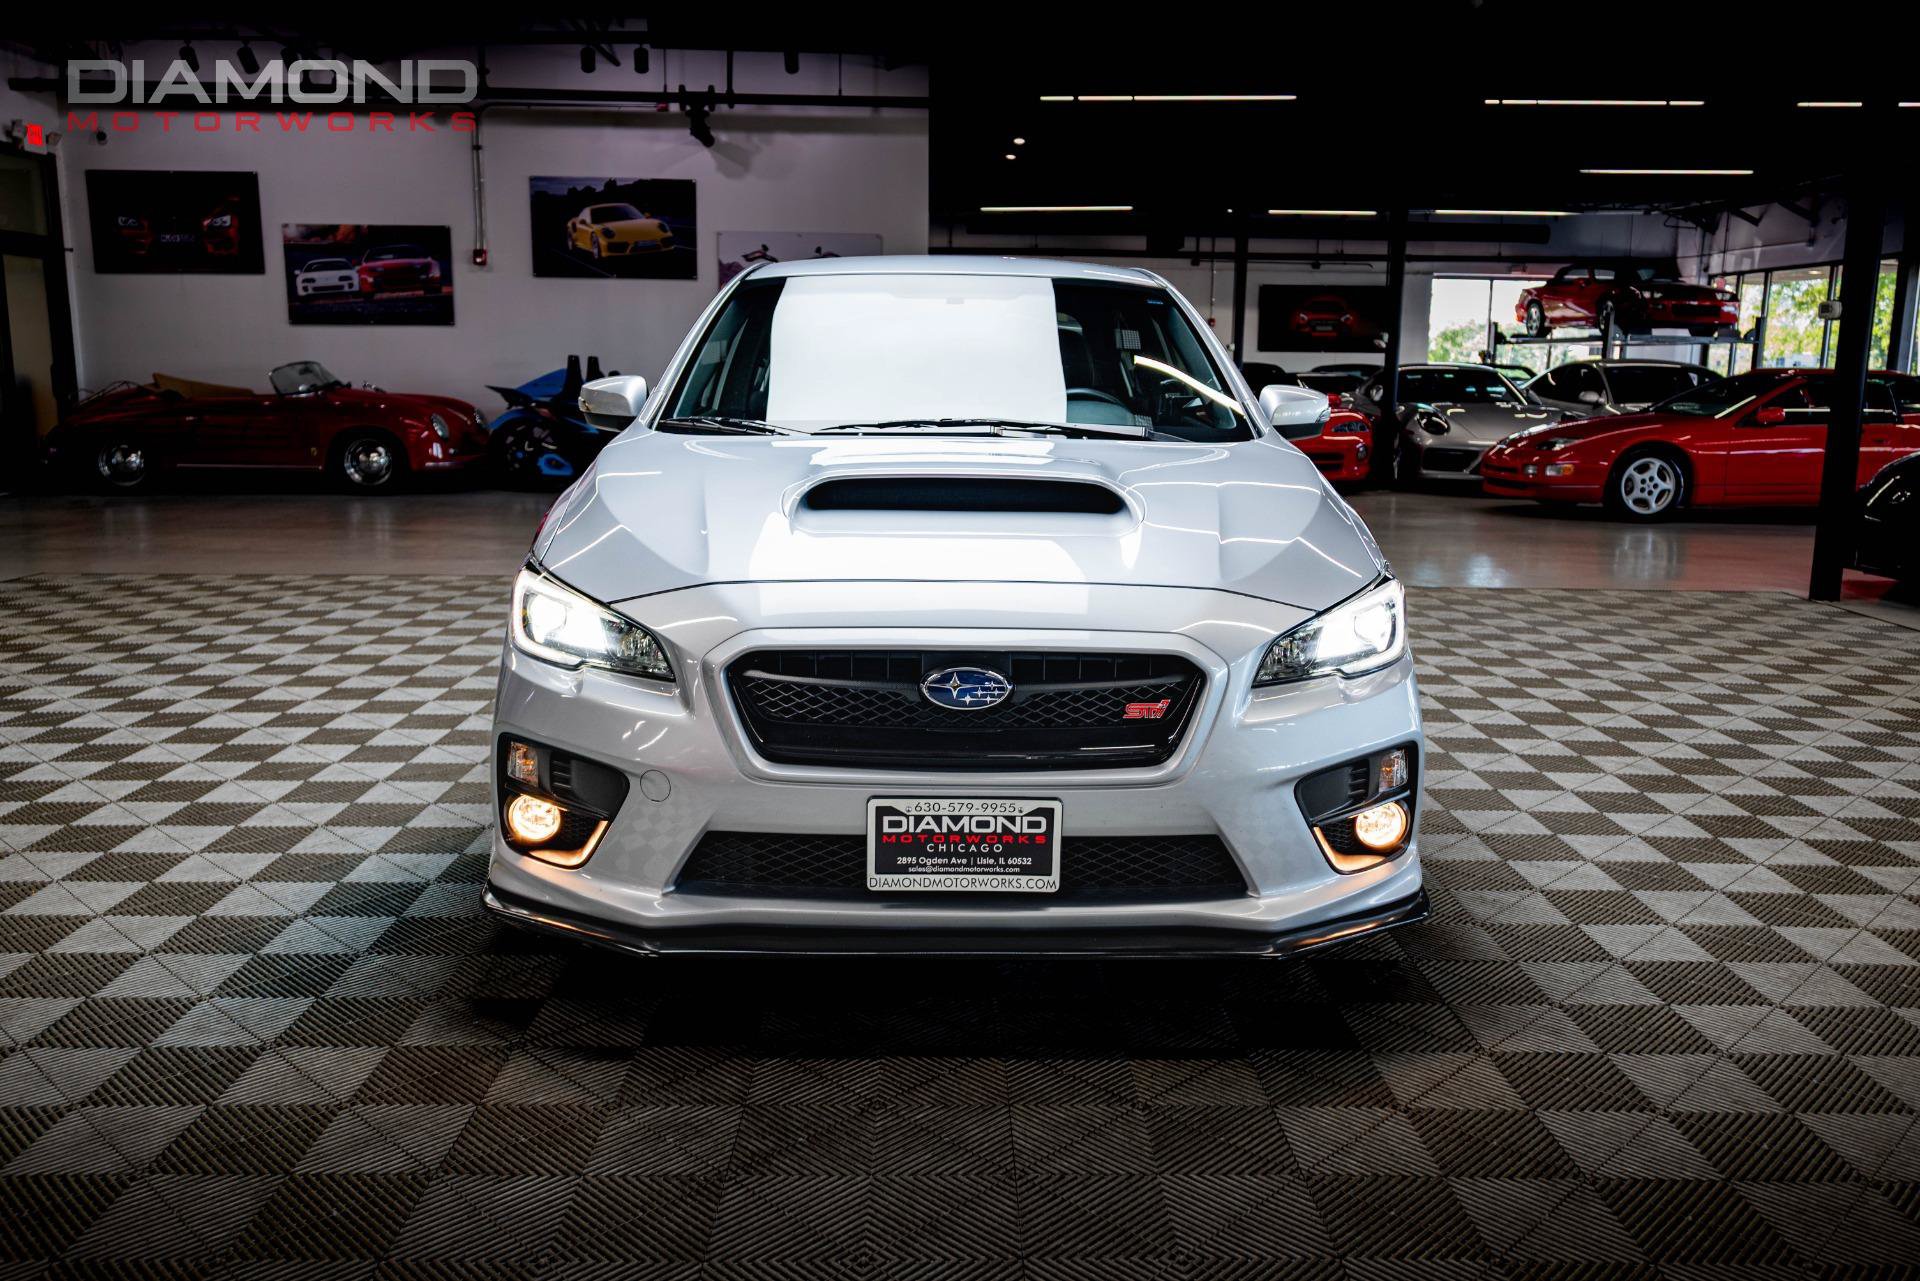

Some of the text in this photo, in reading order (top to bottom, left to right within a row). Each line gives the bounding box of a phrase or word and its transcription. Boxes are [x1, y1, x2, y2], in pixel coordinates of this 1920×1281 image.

[914, 802, 1016, 813] 630-579-9955
[882, 815, 1047, 834] DIAMOND
[881, 834, 1047, 844] MOTORWORKS
[926, 843, 1003, 853] CHICAGO
[919, 857, 949, 865] Ogden
[999, 857, 1006, 865] IL
[1007, 857, 1032, 865] 60532
[908, 865, 1020, 873] sales@diamondmotorworks.com
[869, 877, 1057, 890] DIAMONDMOTORWORKS.COM
